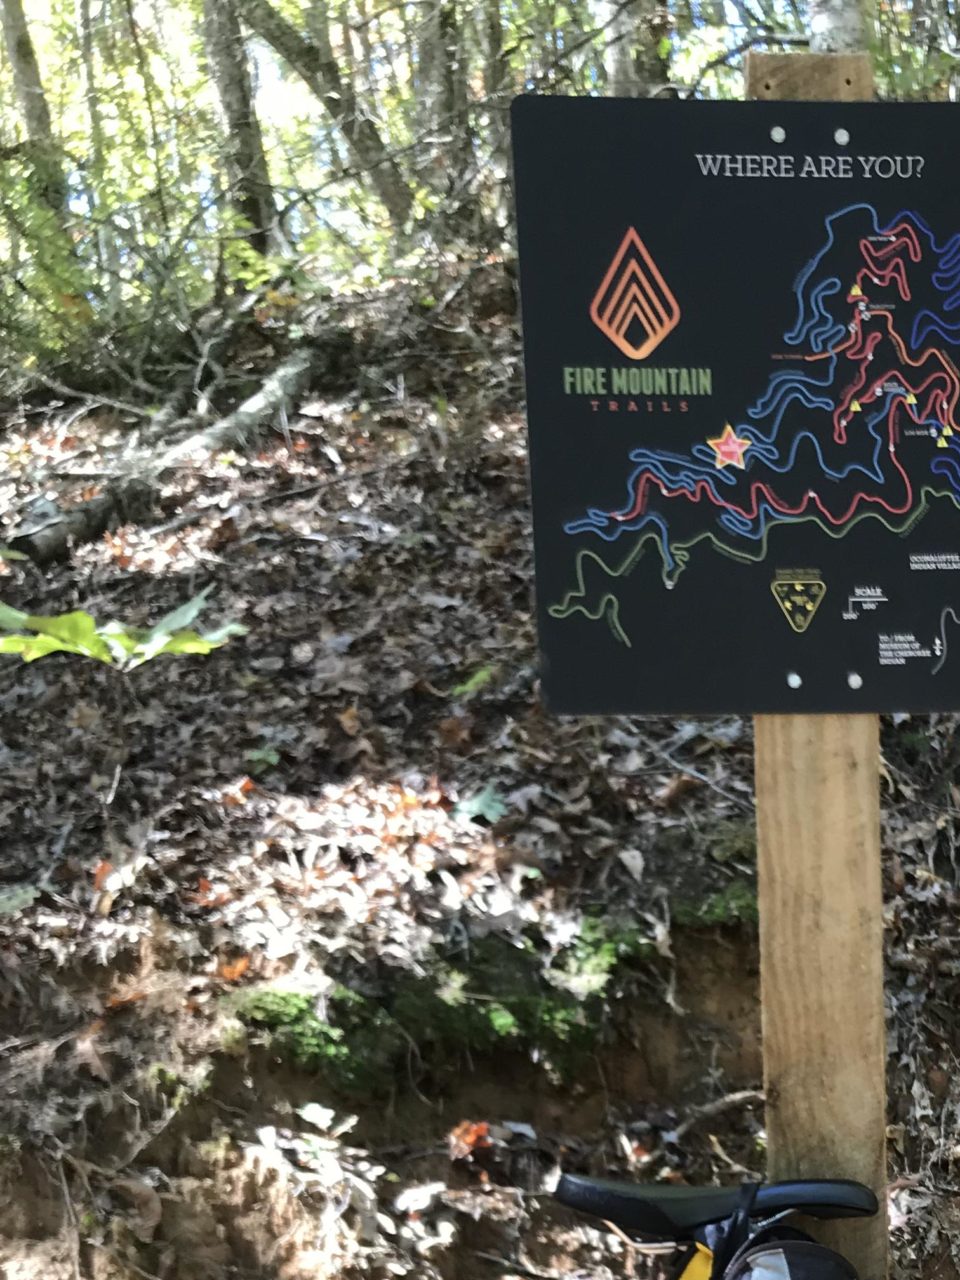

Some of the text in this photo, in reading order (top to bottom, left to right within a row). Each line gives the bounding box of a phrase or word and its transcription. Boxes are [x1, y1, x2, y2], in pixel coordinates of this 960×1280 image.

[694, 153, 925, 179] WHERE ARE YOU?
[563, 367, 713, 395] FIRE MOUNTAIN
[590, 400, 689, 412] TRAILS
[854, 587, 883, 597] SCALE
